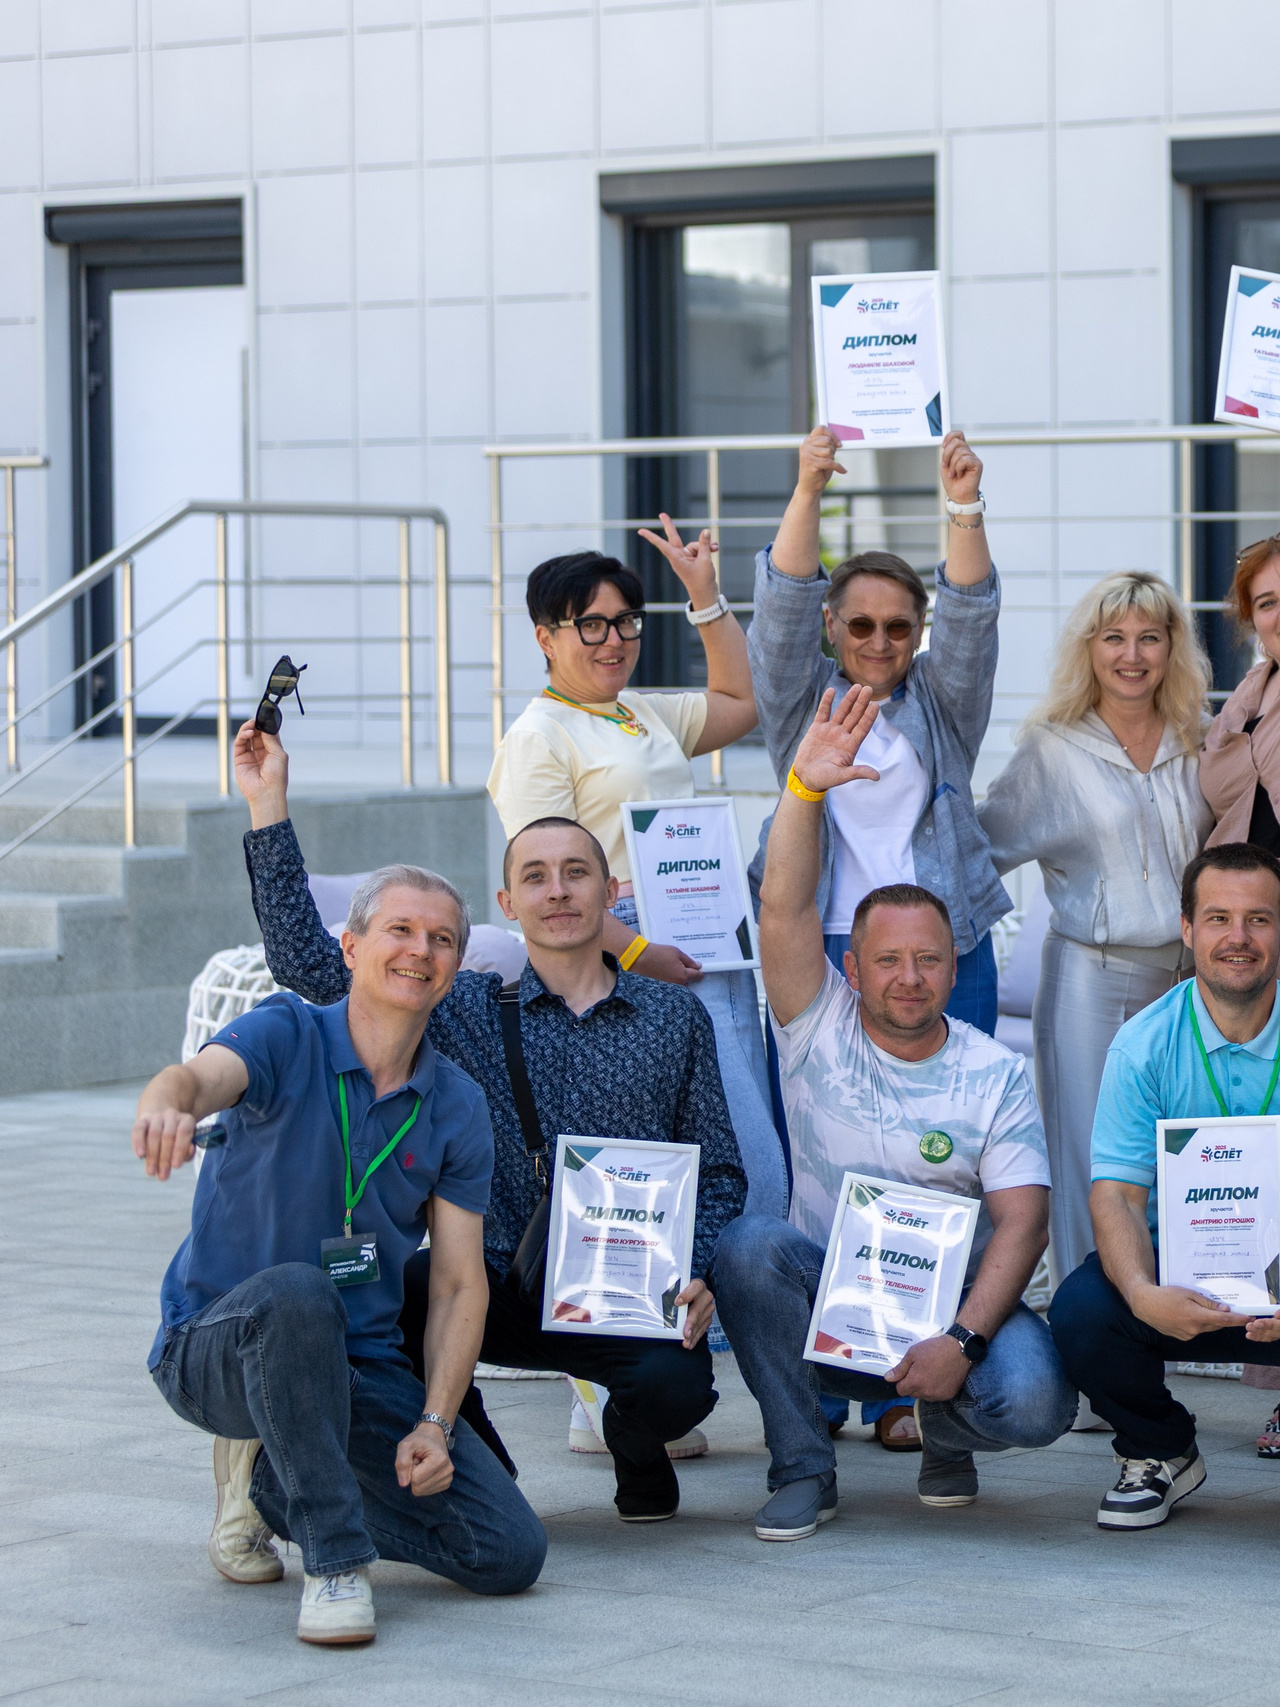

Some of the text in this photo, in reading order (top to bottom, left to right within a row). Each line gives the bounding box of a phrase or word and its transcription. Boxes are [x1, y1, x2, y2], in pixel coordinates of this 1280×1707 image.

[871, 300, 899, 311] СЛЁТ
[843, 334, 917, 350] ДИПЛОМ
[677, 826, 701, 836] СЛЁТ
[657, 859, 720, 875] ДИПЛОМ
[1214, 1148, 1243, 1159] СЛЁТ
[618, 1170, 650, 1182] СЛЁТ
[1185, 1187, 1259, 1203] ДИПЛОМ
[581, 1206, 665, 1223] ДИПЛОМ
[897, 1217, 929, 1229] СЛЁТ
[582, 1236, 660, 1247] ДМИТРИЮ КУРГУЗОВУ
[855, 1245, 937, 1272] ДИПЛОМ
[330, 1264, 367, 1275] АЛЕКСАНДР
[885, 1280, 926, 1293] ТЕЛЕЖКИНУ
